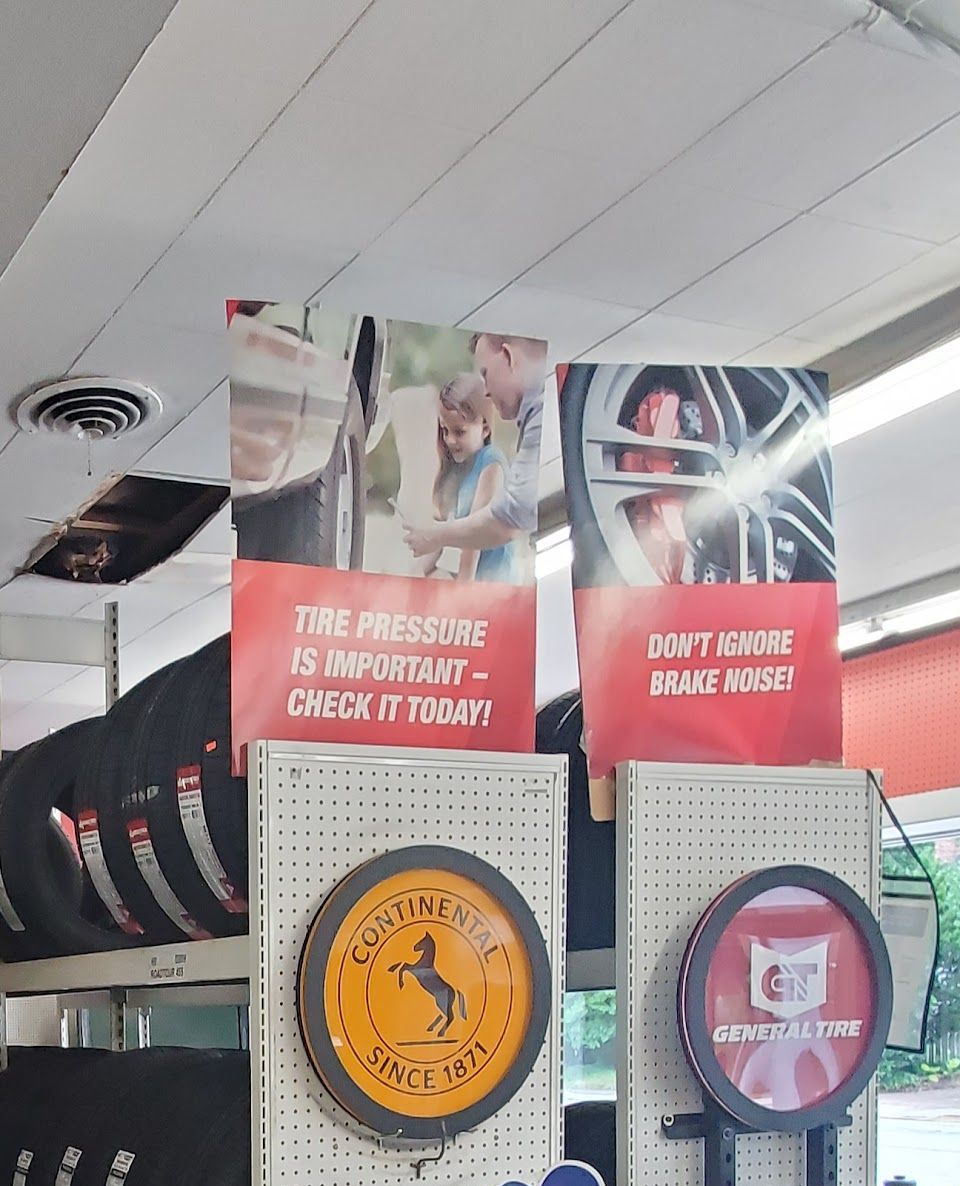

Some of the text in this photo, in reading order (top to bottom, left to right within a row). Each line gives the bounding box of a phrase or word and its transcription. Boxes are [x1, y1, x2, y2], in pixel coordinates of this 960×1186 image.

[295, 604, 489, 648] TIRE PRESSURE
[647, 630, 794, 660] DON'T IGNORE
[291, 646, 318, 676] IS
[324, 649, 468, 686] IMPORTANT
[649, 666, 795, 696] BRAKE NOISE!
[287, 688, 493, 728] CHECK IT TODAY!
[351, 895, 501, 965] CONTINENTAL
[712, 1020, 863, 1043] GENERAL TIRE
[366, 1040, 489, 1089] SINCE 1871
